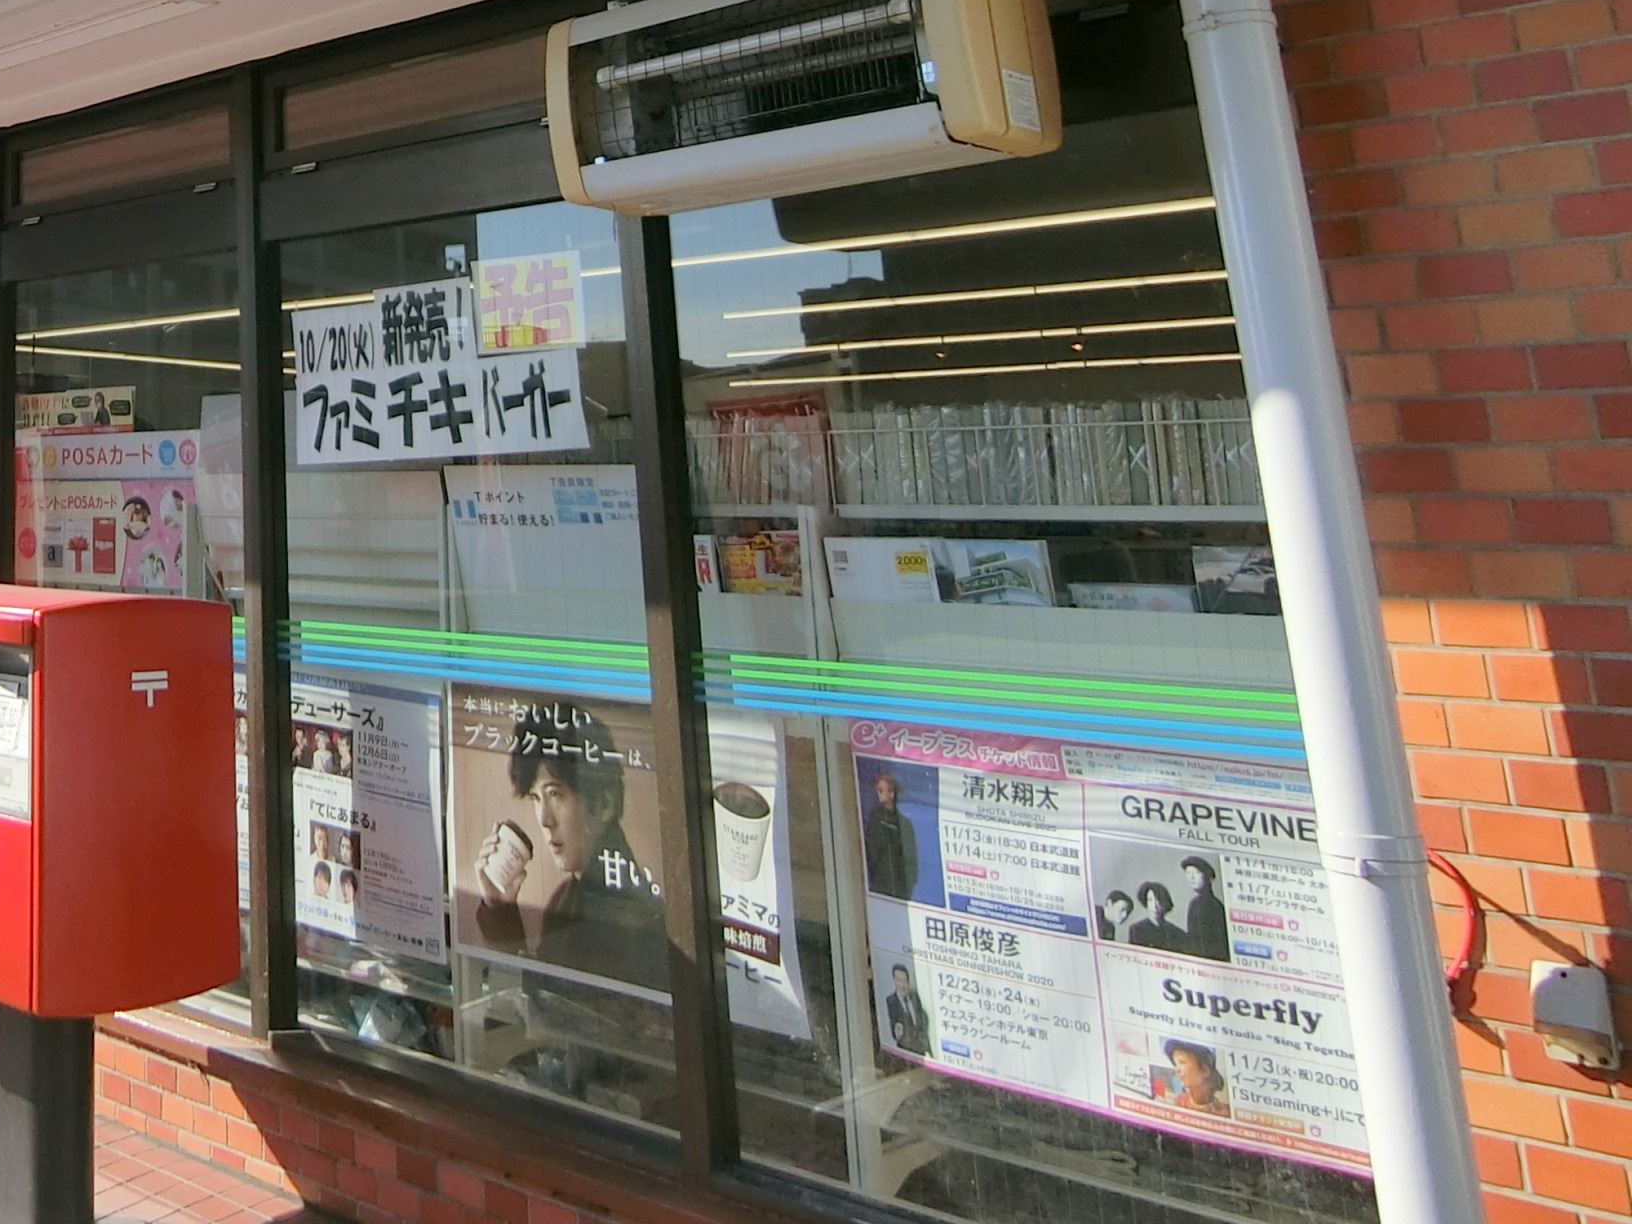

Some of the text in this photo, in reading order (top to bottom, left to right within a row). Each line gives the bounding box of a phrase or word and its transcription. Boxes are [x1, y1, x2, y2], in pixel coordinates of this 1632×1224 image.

[302, 359, 572, 453] ファミチキバーガー
[61, 443, 153, 466] POSAカード
[463, 695, 593, 730] 本当においしい
[889, 729, 977, 760] イープラス
[962, 774, 1060, 811] 清水翔太
[1121, 794, 1318, 843] GRAPEVINE
[1178, 827, 1261, 849] FALL TOUR
[598, 848, 661, 896] 甘い。
[925, 917, 1021, 957] 田原俊彦
[977, 999, 1013, 1016] 19:00
[1053, 1015, 1092, 1033] 20:00
[1128, 1005, 1176, 1025] Superfly
[1178, 1016, 1203, 1030] Live
[1221, 1025, 1263, 1042] Studio
[1161, 977, 1324, 1035] Superfly
[1232, 1074, 1296, 1094] イープラス
